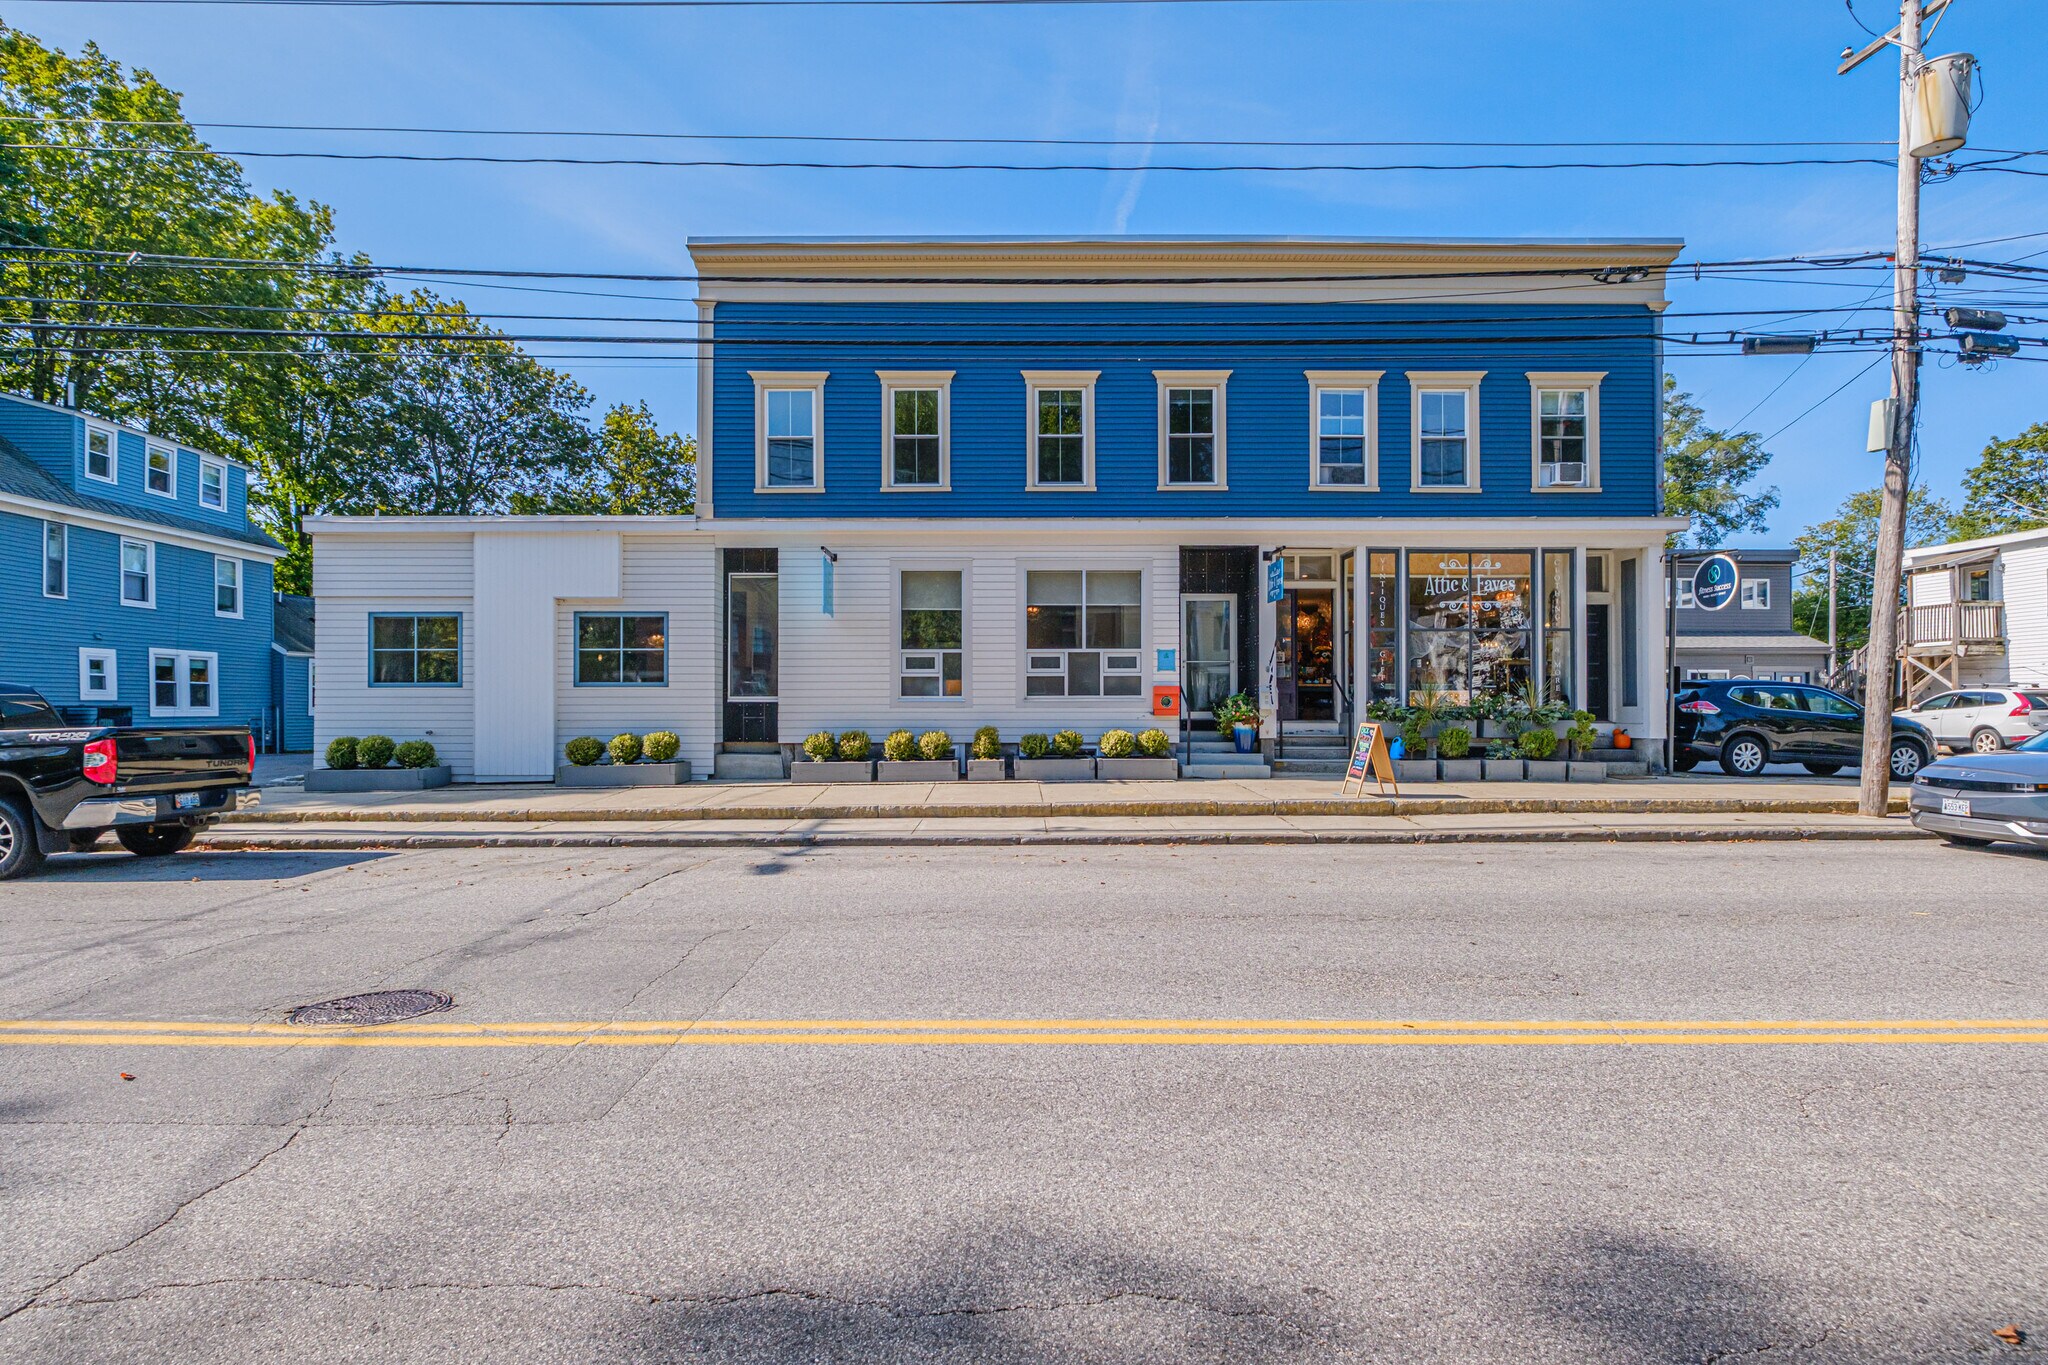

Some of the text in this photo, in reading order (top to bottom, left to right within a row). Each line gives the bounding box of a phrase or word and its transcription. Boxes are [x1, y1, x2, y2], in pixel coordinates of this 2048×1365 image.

[1424, 574, 1516, 596] Attic & Eaves
[205, 760, 248, 768] TUNDRA
